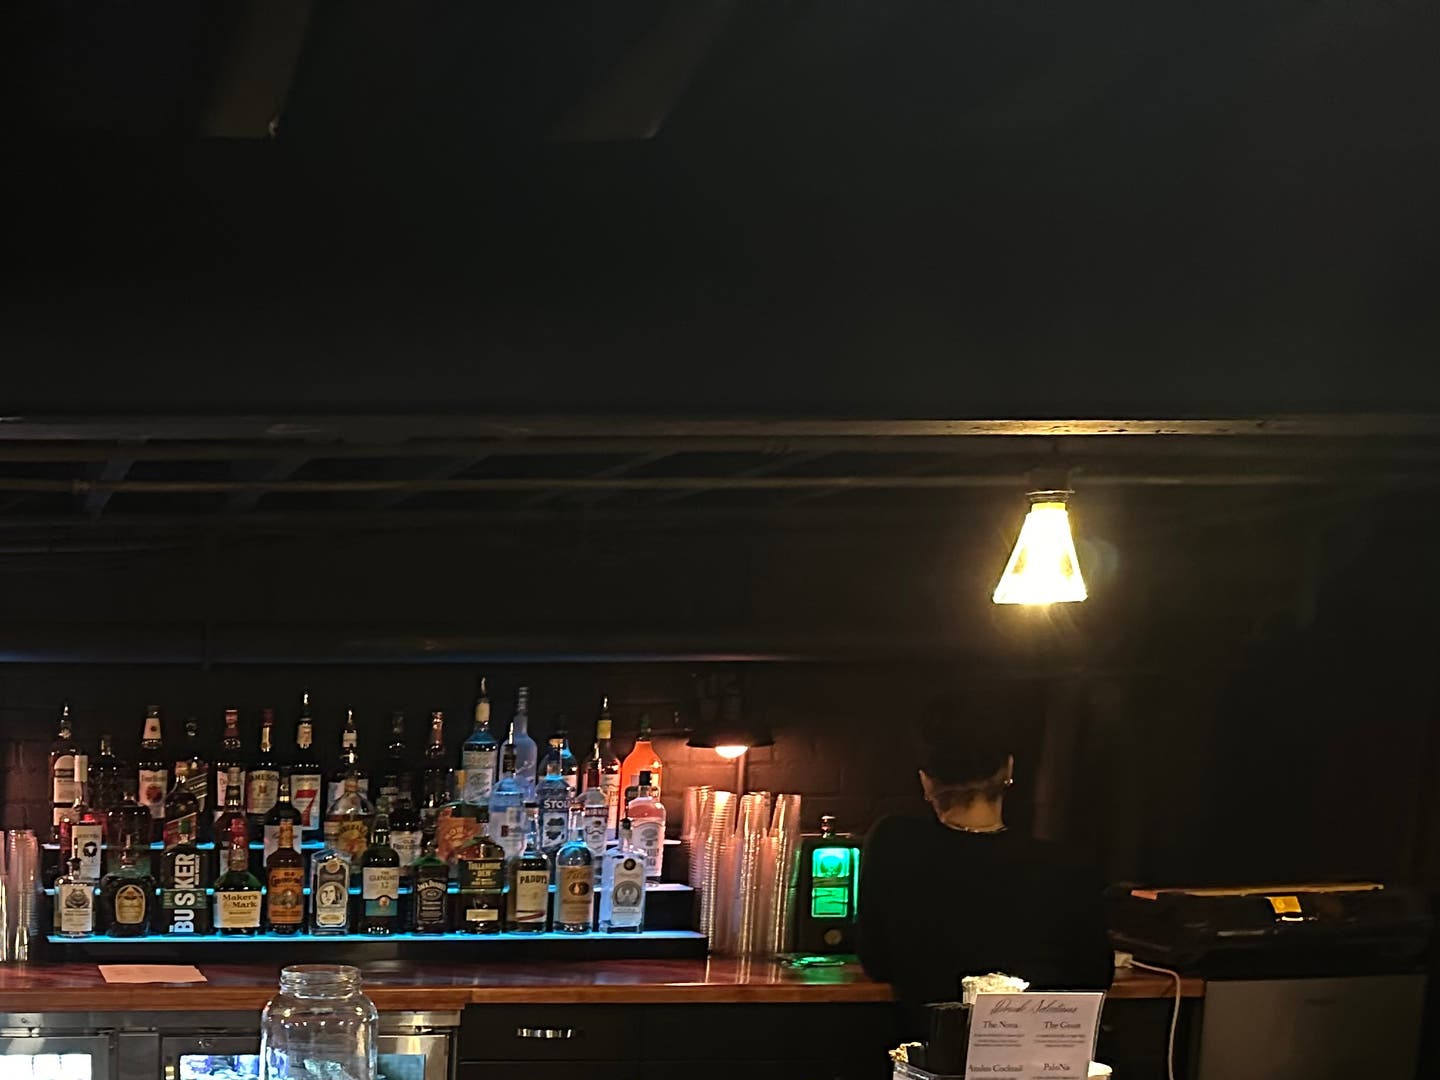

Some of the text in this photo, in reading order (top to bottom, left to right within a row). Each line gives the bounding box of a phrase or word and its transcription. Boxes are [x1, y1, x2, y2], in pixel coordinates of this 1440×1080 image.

[173, 853, 196, 933] BUSKER
[222, 893, 258, 901] Maker's
[231, 900, 257, 908] Mark
